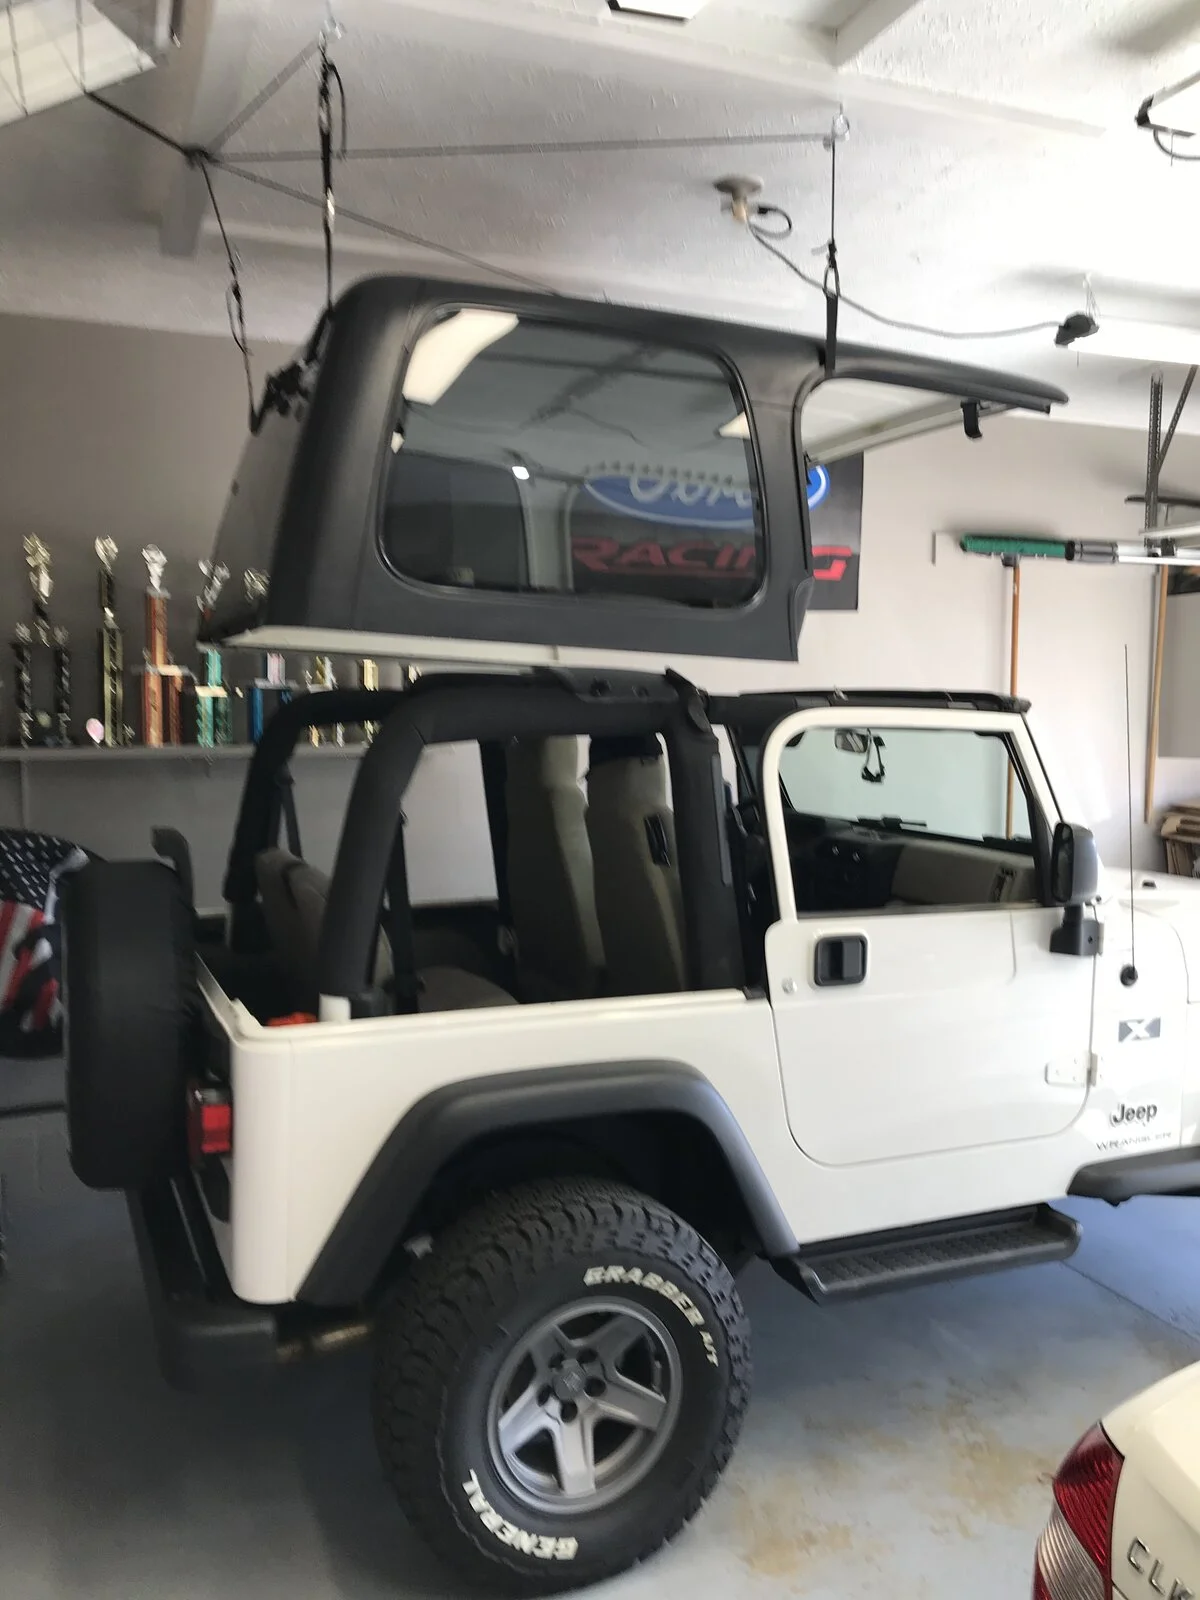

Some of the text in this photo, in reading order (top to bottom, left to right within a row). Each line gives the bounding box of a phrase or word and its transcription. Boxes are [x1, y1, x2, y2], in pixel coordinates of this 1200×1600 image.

[1111, 1102, 1158, 1125] Jeep
[583, 1265, 705, 1327] GRABBER
[462, 1468, 579, 1560] GENERAL
